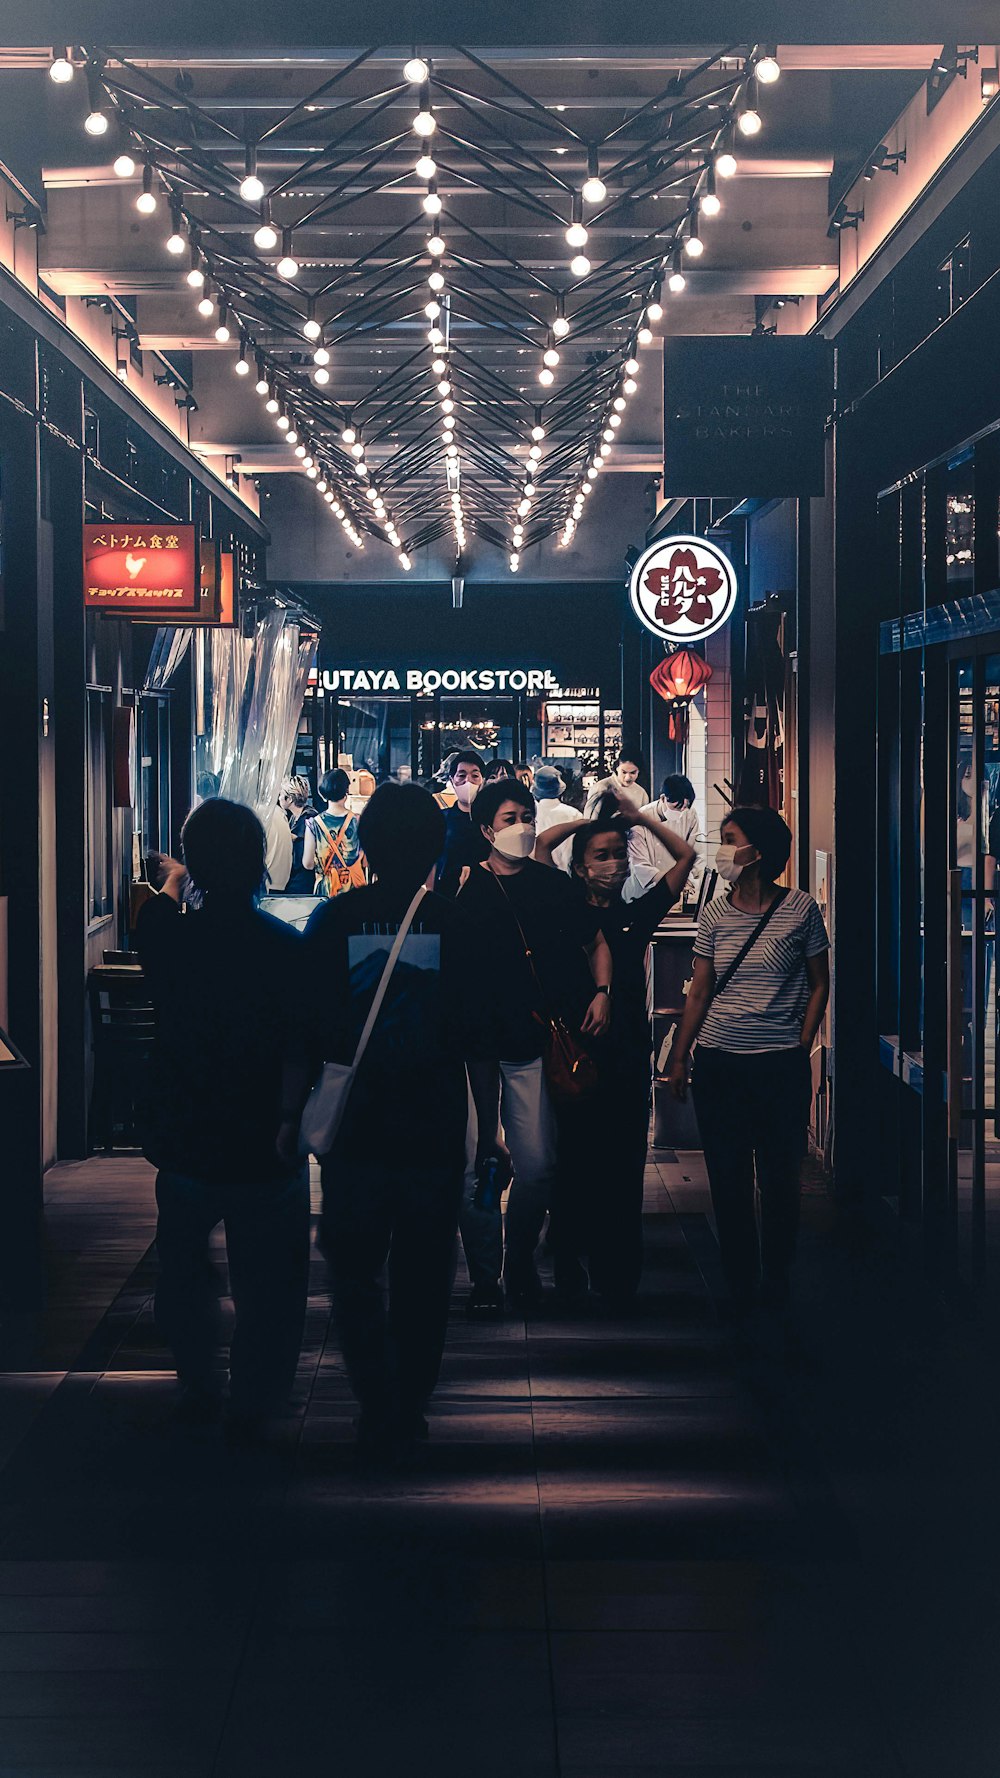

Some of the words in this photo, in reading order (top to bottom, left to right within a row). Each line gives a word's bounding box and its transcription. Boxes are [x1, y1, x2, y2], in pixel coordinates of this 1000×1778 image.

[722, 384, 764, 397] THE
[676, 404, 808, 419] STANDAR
[93, 534, 179, 549] ベトナム食堂
[88, 586, 183, 598] チョップスティックス
[660, 575, 670, 606] ビストロ
[671, 566, 697, 614] ハルタ
[407, 669, 559, 691] BOOKSTORE
